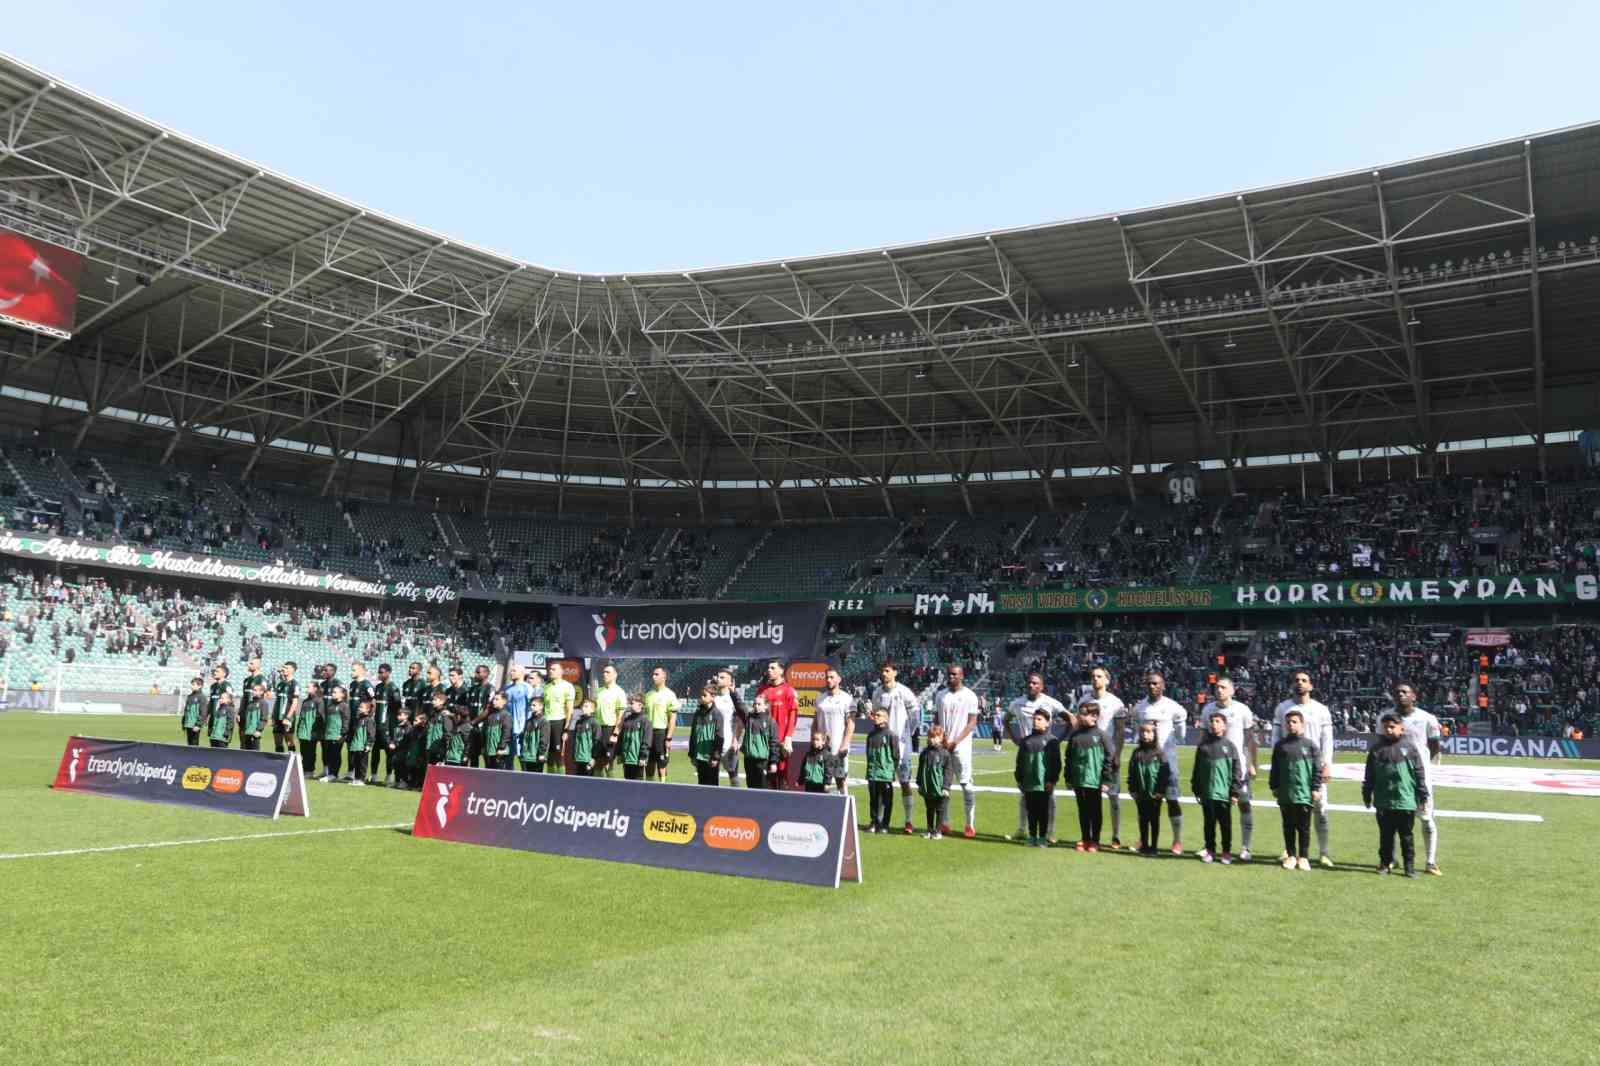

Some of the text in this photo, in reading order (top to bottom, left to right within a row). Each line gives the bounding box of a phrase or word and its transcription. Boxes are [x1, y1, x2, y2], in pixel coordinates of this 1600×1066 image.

[324, 573, 387, 596] Vermesin
[1236, 583, 1344, 606] HODRI
[1389, 576, 1557, 602] MEYDAN
[828, 599, 864, 611] RFEZ
[620, 617, 706, 645] trendyol
[791, 670, 826, 682] trendyo
[1438, 736, 1564, 759] MEDICANA
[87, 755, 136, 778] trendyol
[466, 792, 554, 826] trendyol
[649, 818, 689, 835] NESİNE
[709, 825, 755, 842] trendyol
